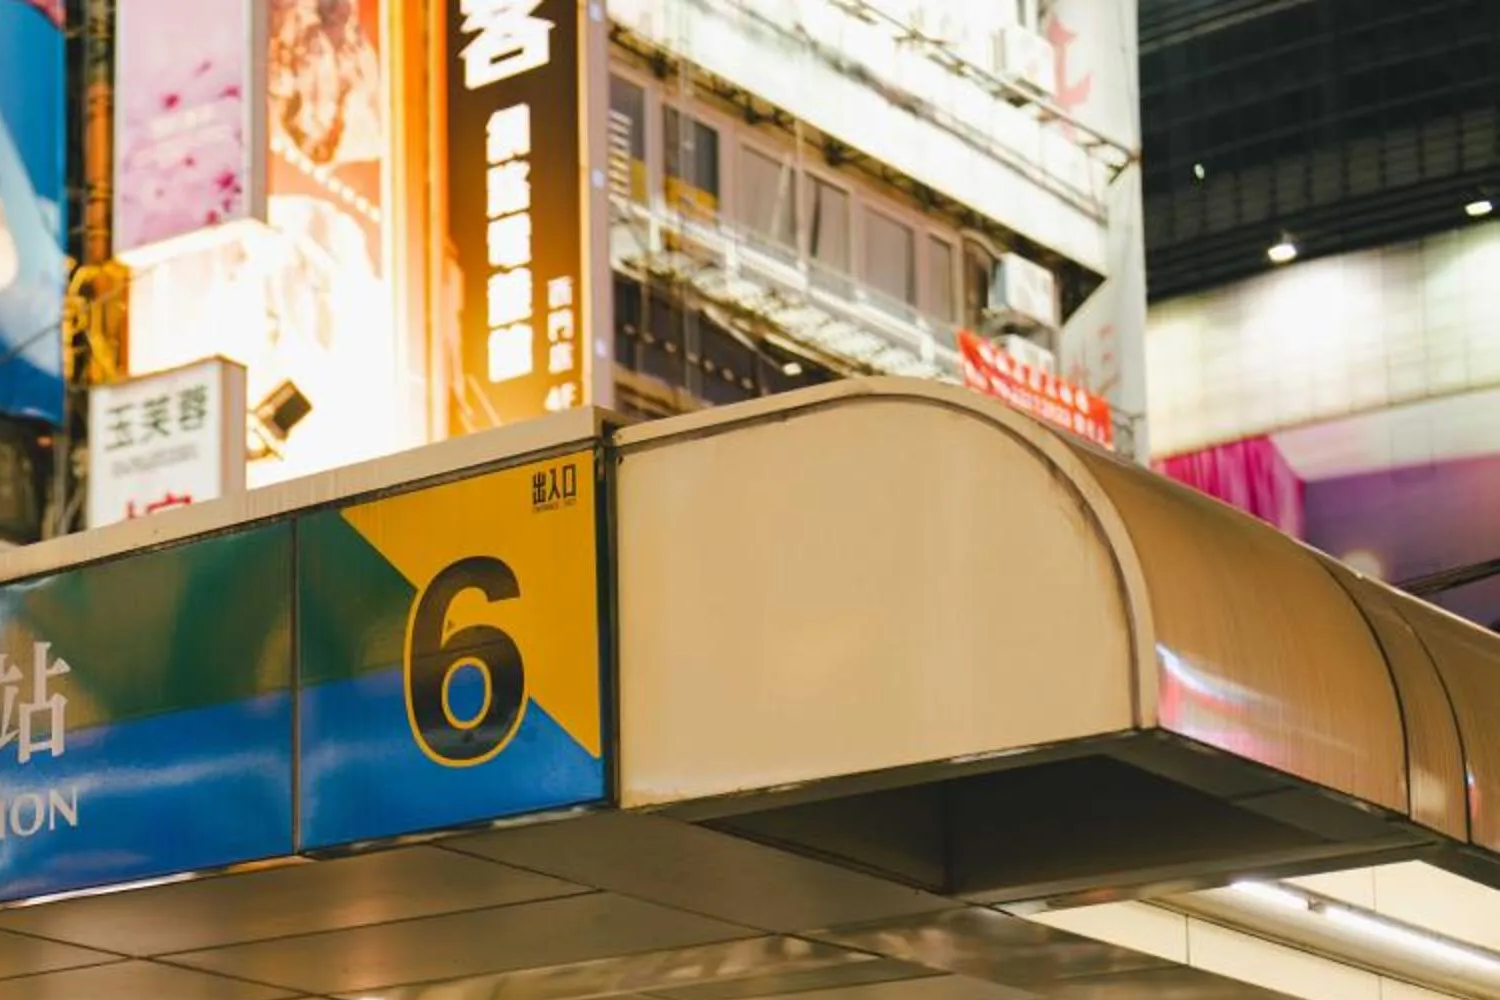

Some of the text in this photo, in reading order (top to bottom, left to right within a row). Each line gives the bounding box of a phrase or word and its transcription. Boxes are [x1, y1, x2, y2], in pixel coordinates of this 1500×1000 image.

[532, 463, 577, 506] 出入口
[402, 554, 527, 769] 6
